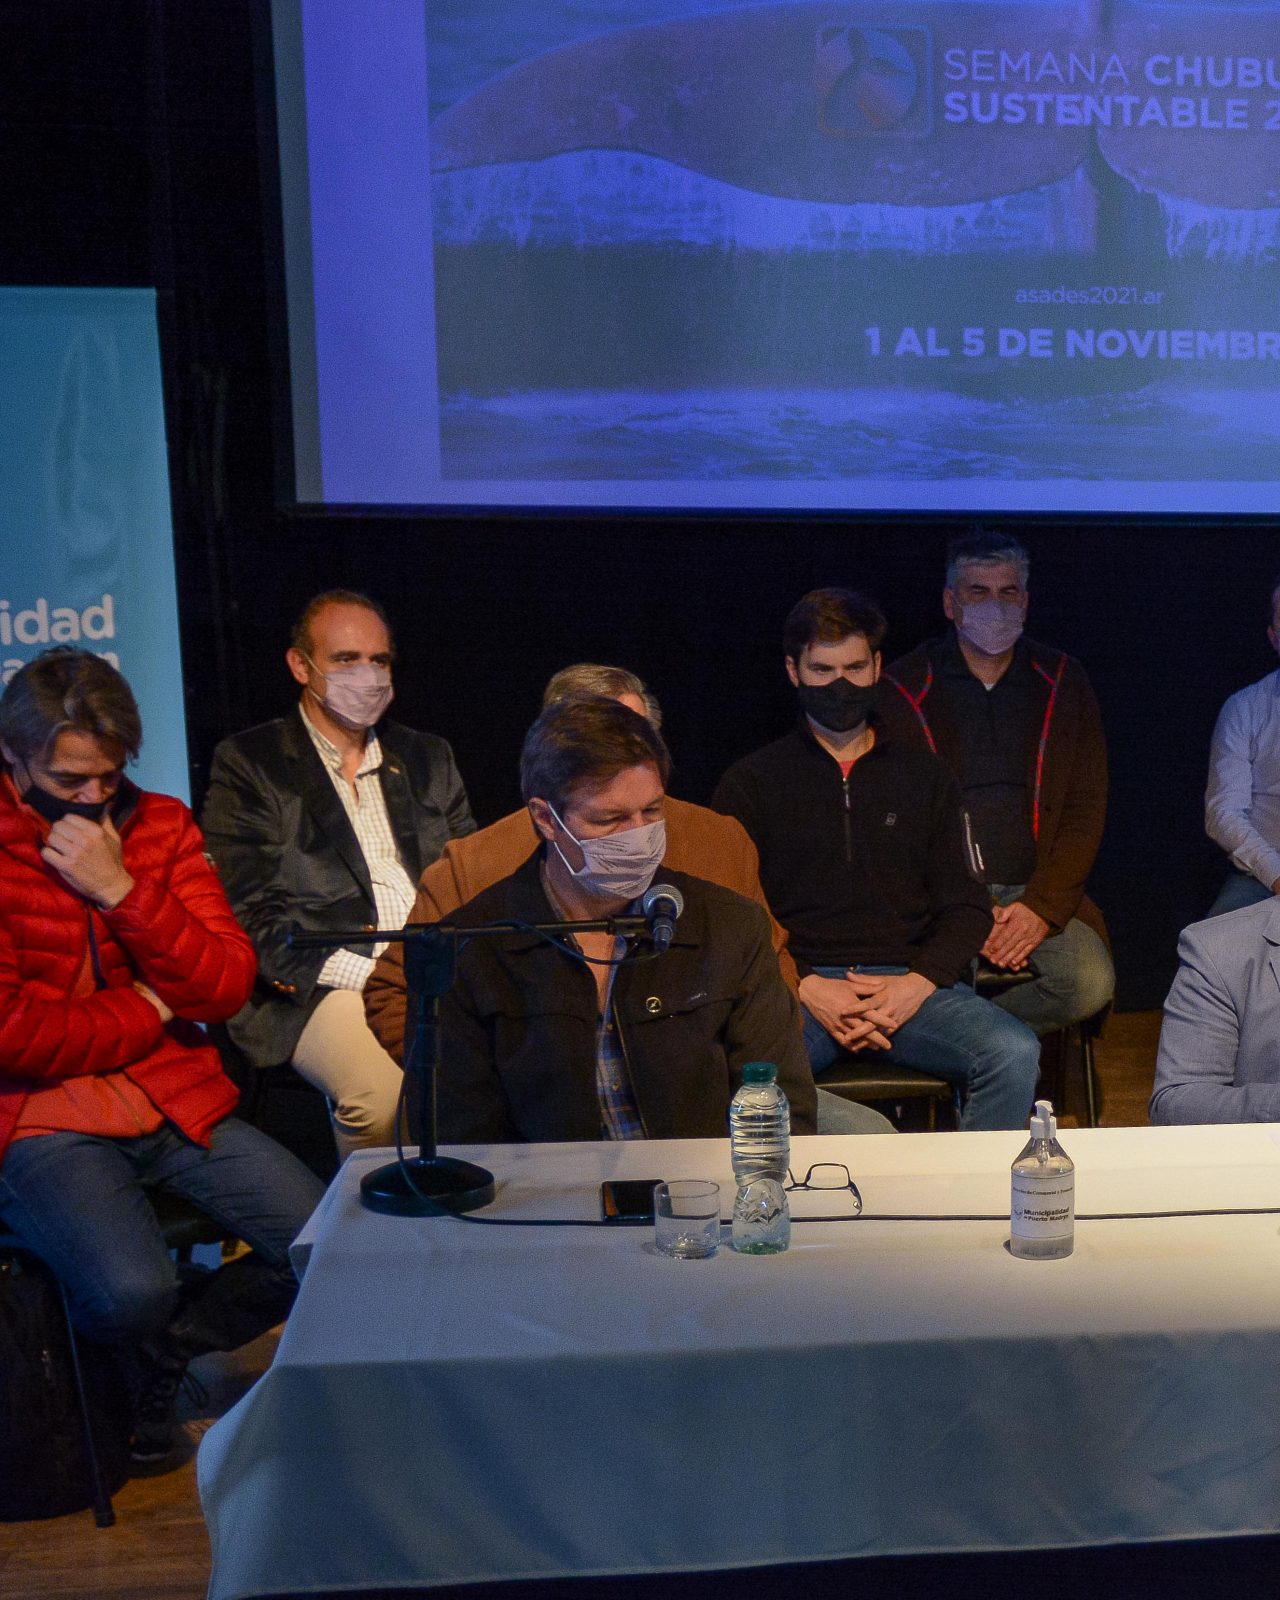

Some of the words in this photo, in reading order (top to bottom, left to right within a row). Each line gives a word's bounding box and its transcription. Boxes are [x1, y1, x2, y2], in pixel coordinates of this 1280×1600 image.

[944, 48, 1131, 86] SEMANA
[943, 90, 1250, 130] SUSTENTABLE
[1014, 286, 1164, 306] asades2021.ar
[865, 326, 882, 357] 1
[894, 327, 951, 358] AL
[962, 327, 986, 358] 5
[999, 328, 1055, 359] DE
